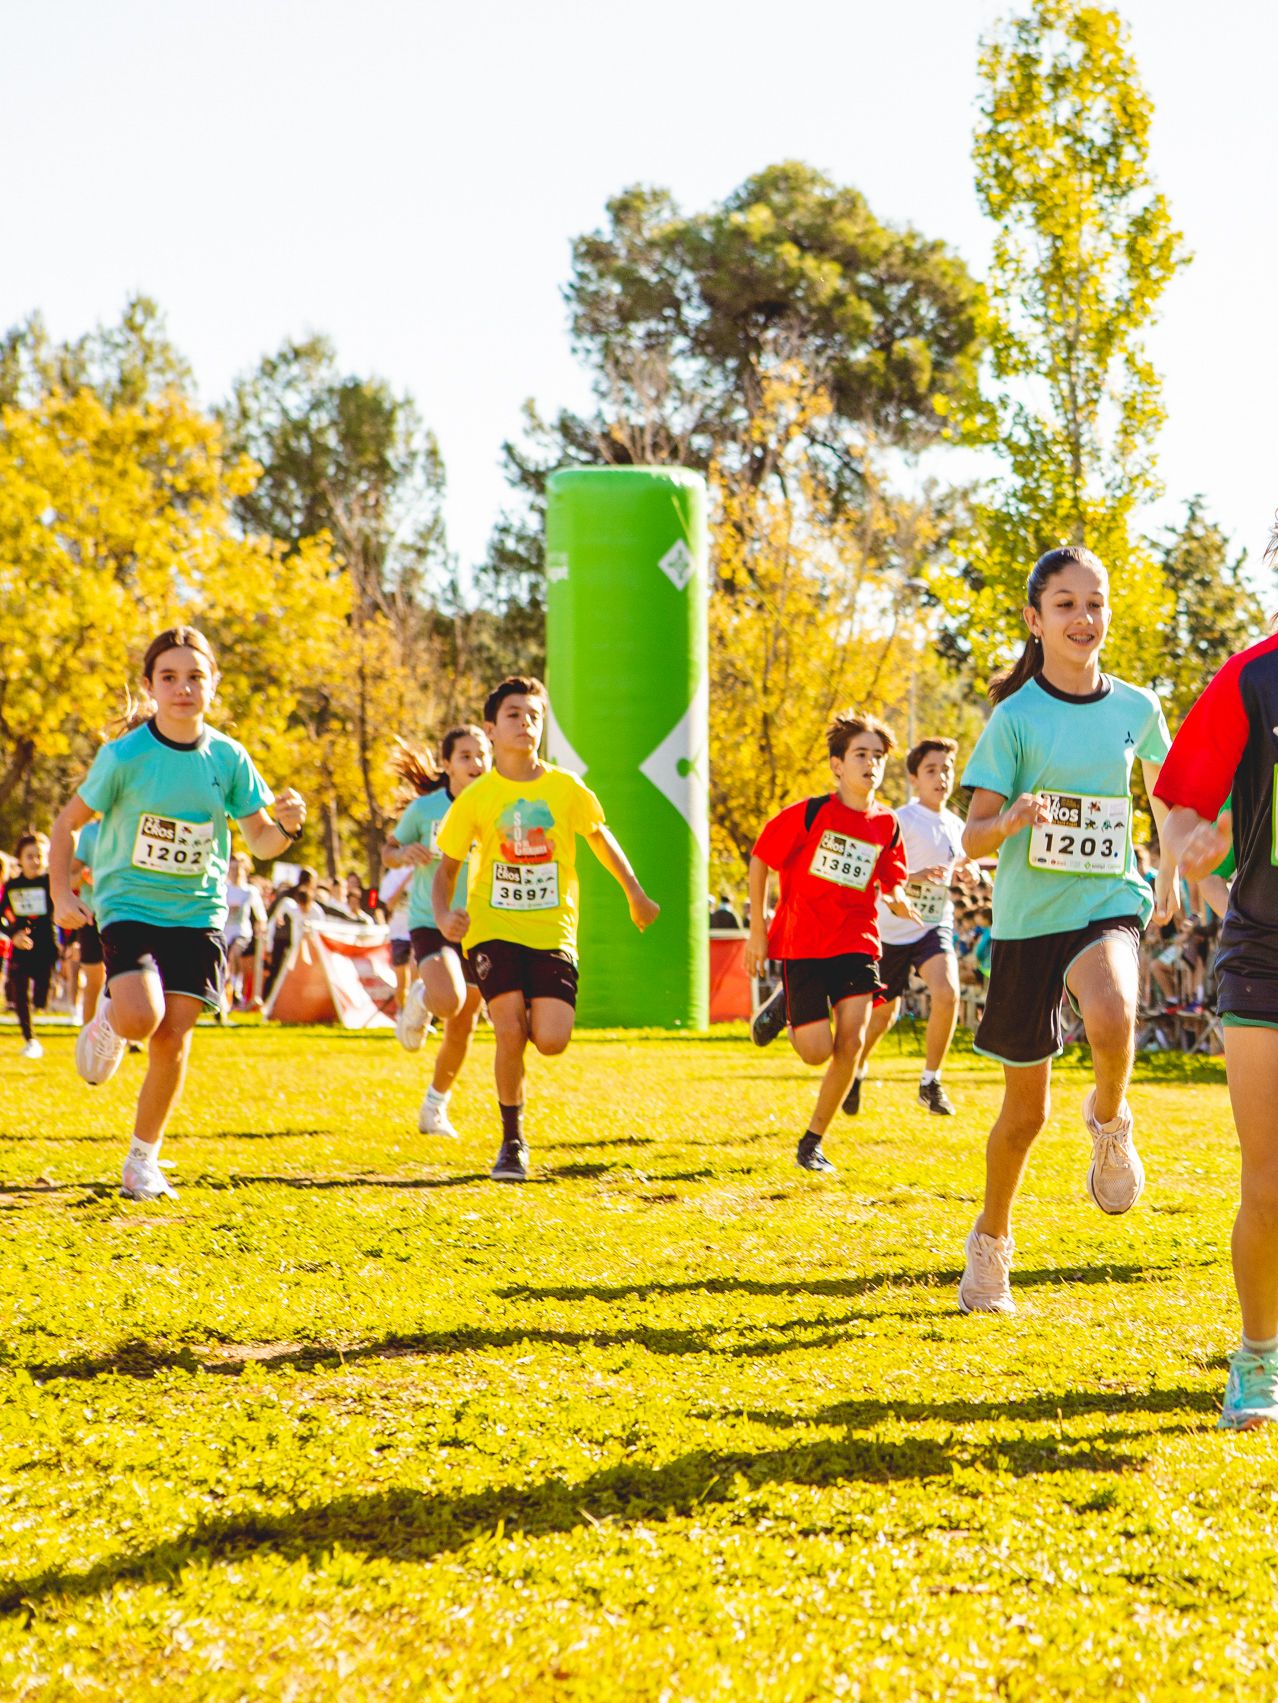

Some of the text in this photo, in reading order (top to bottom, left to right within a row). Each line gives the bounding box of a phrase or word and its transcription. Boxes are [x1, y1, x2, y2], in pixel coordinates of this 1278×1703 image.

[1050, 806, 1078, 822] ROS
[147, 844, 202, 864] 1202
[822, 856, 861, 878] 1389
[500, 887, 547, 901] 3697
